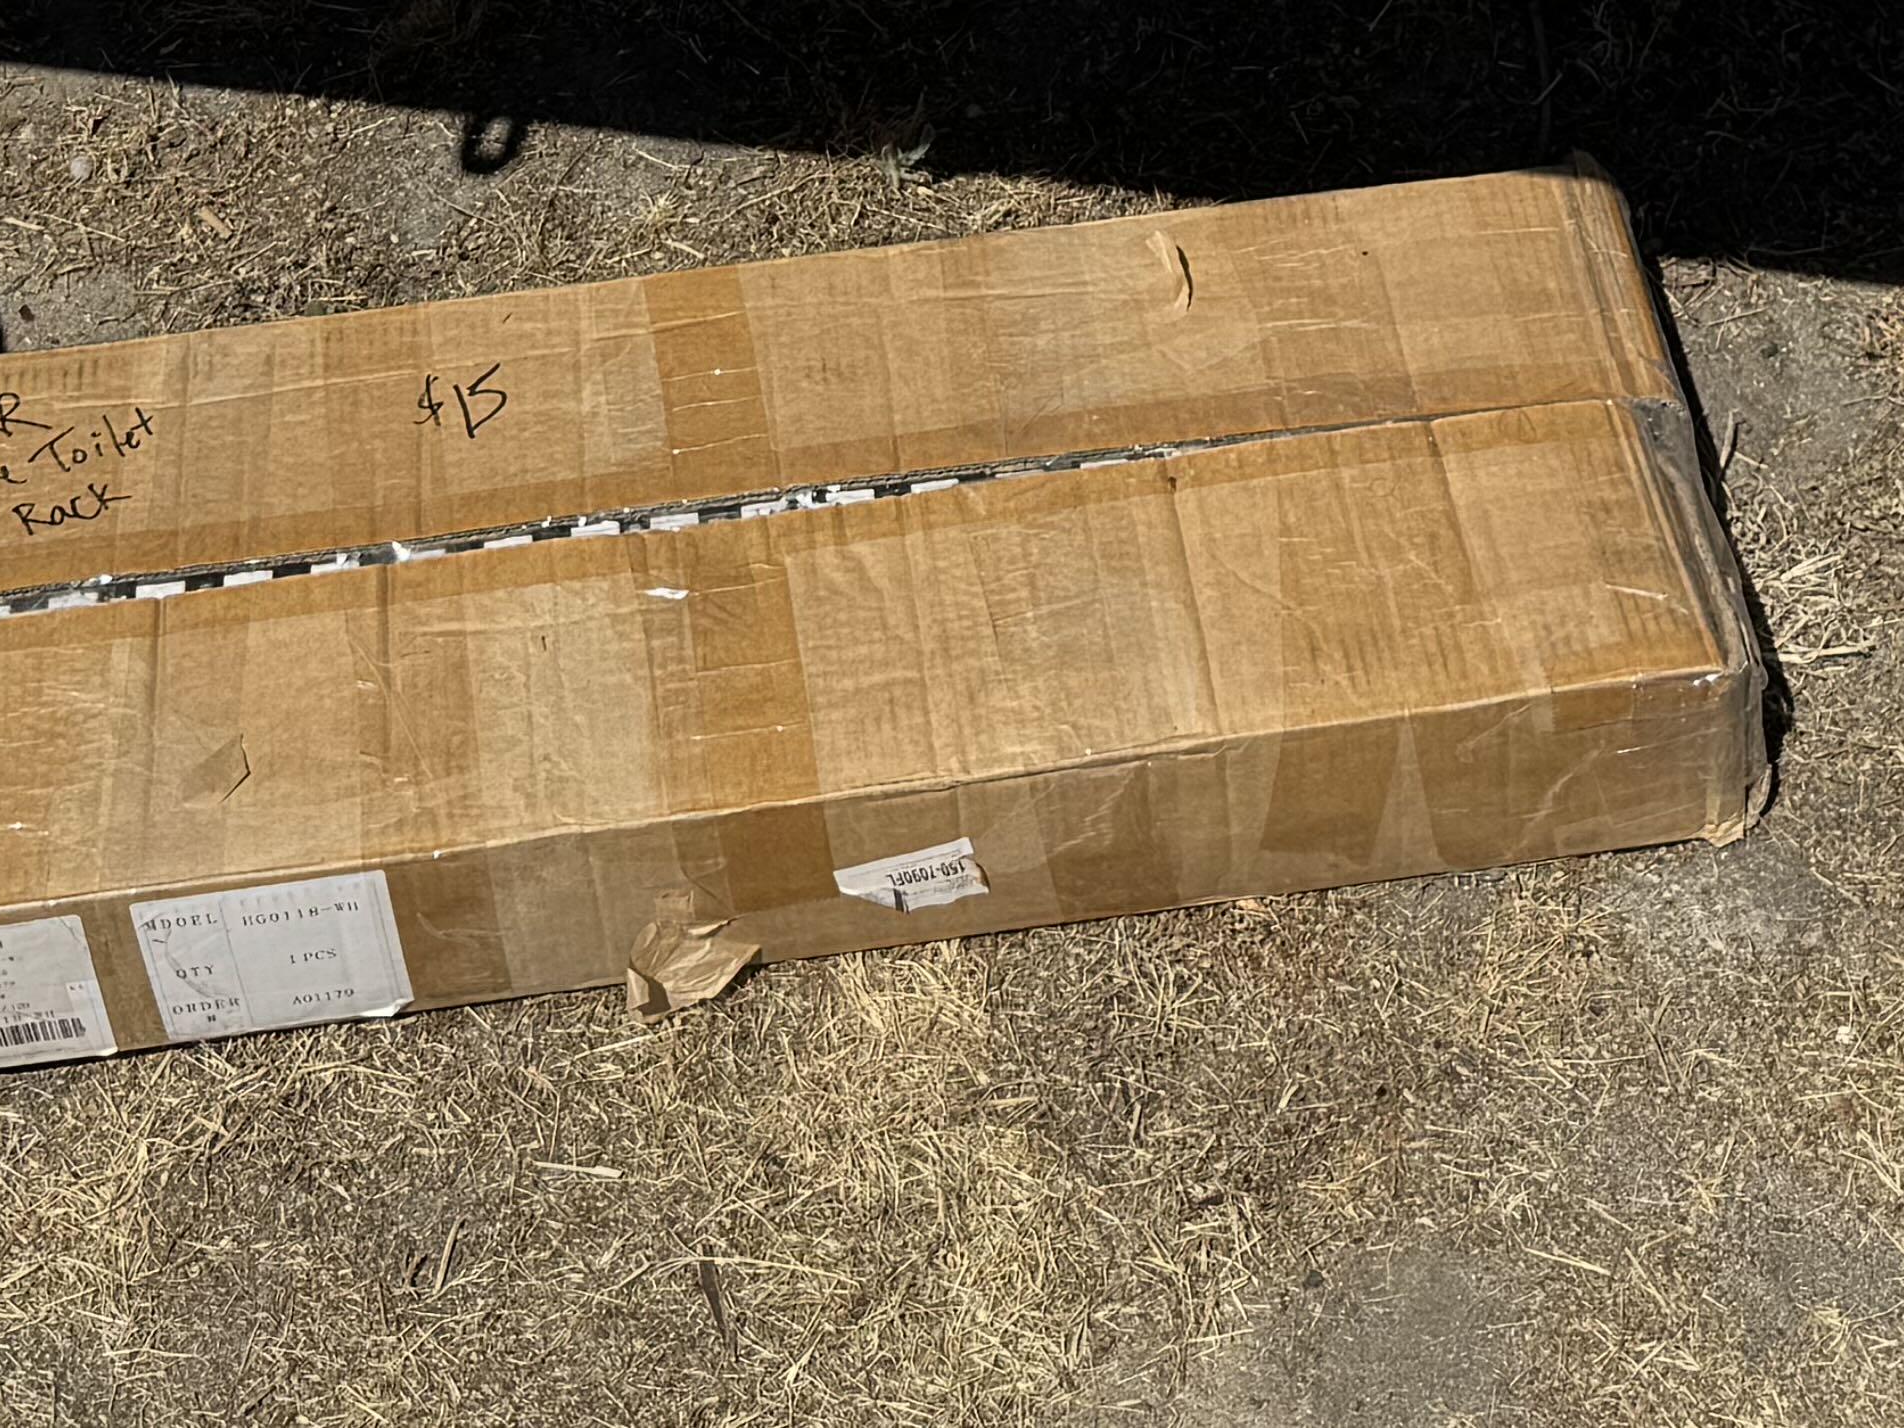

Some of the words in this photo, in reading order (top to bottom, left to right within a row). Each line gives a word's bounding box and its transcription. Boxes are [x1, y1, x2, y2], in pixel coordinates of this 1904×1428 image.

[413, 362, 508, 439] $15
[28, 407, 154, 472] Toilet
[12, 483, 132, 536] Rack
[303, 948, 338, 963] PCS
[172, 996, 241, 1017] ORDER
